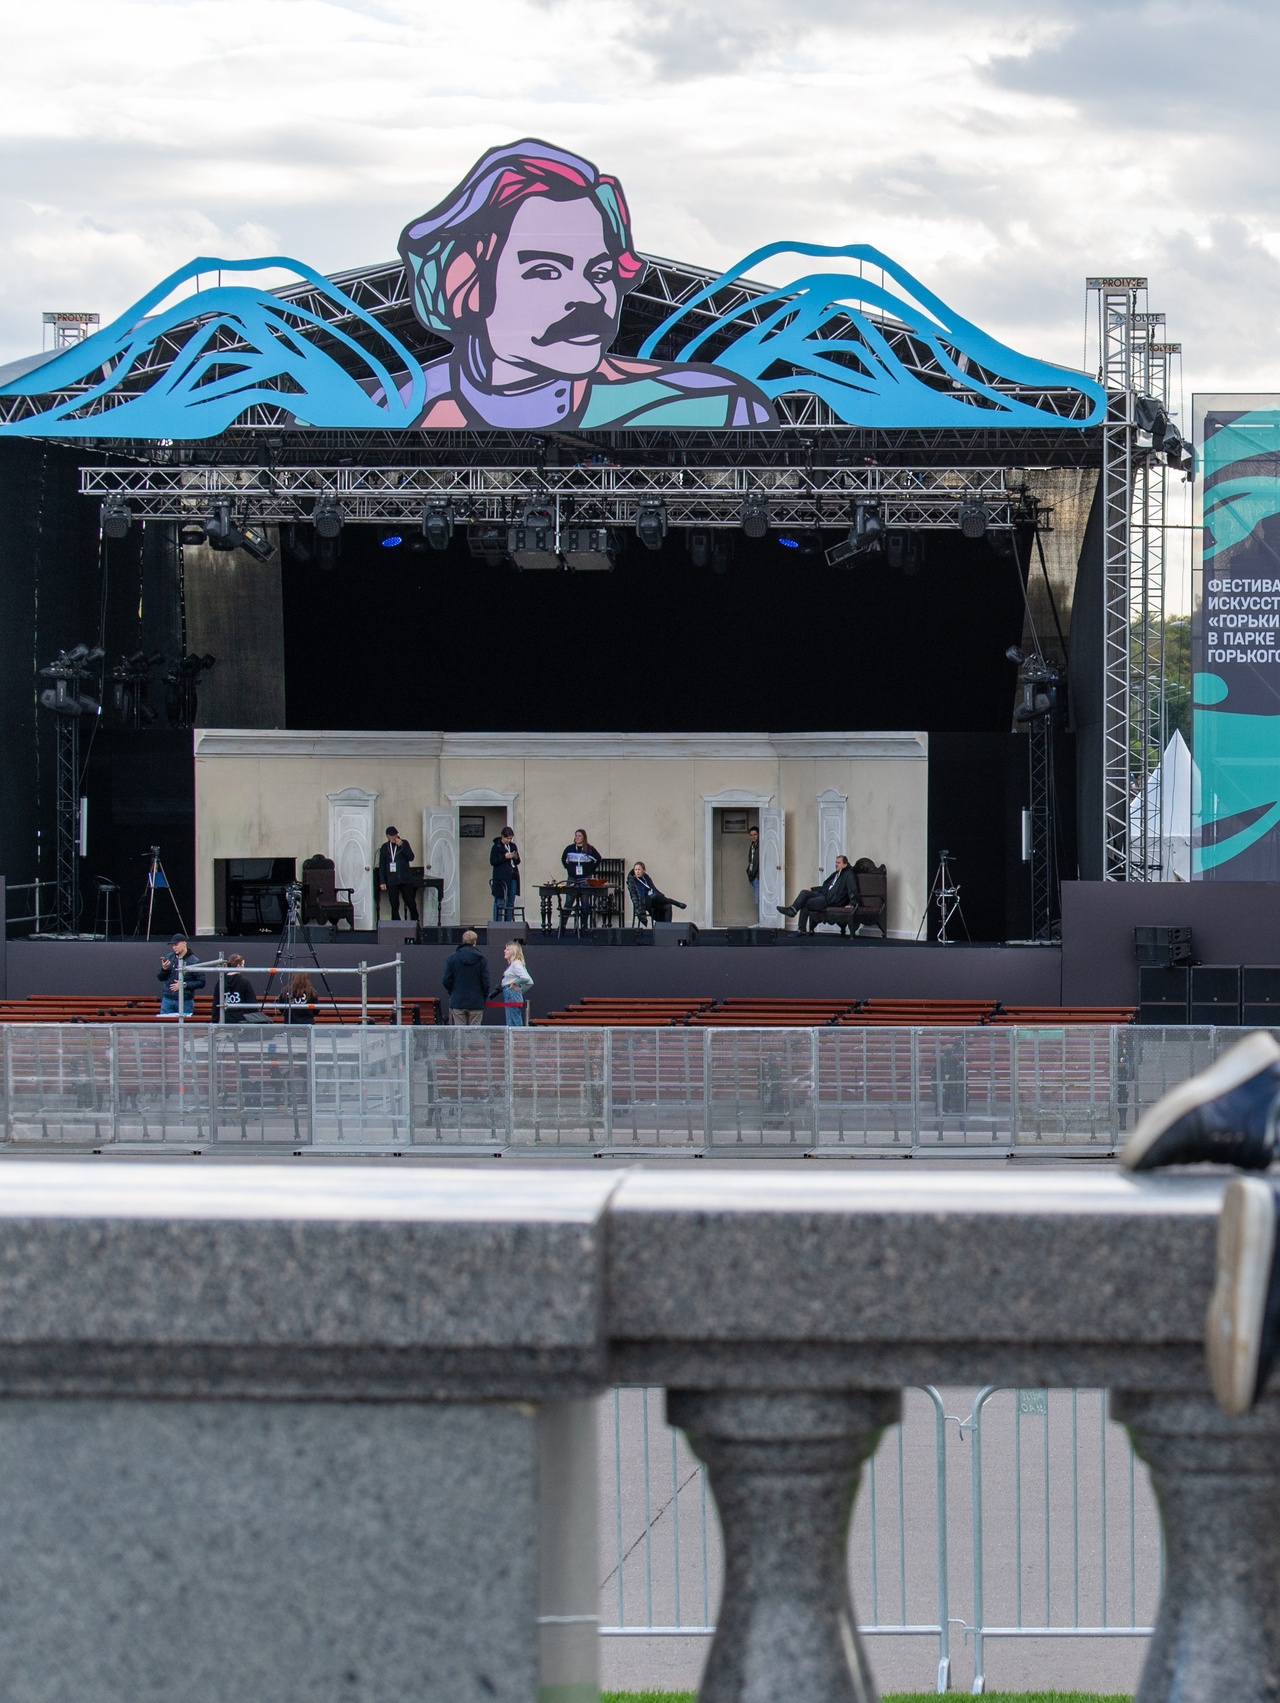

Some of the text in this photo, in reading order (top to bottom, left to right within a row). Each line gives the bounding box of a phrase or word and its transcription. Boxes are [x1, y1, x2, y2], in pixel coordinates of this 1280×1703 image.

[1103, 279, 1142, 287] PROLYTE
[57, 313, 93, 322] PROLYTE
[1129, 314, 1160, 323] ROLYTE
[1208, 632, 1275, 645] В ПАРКЕ
